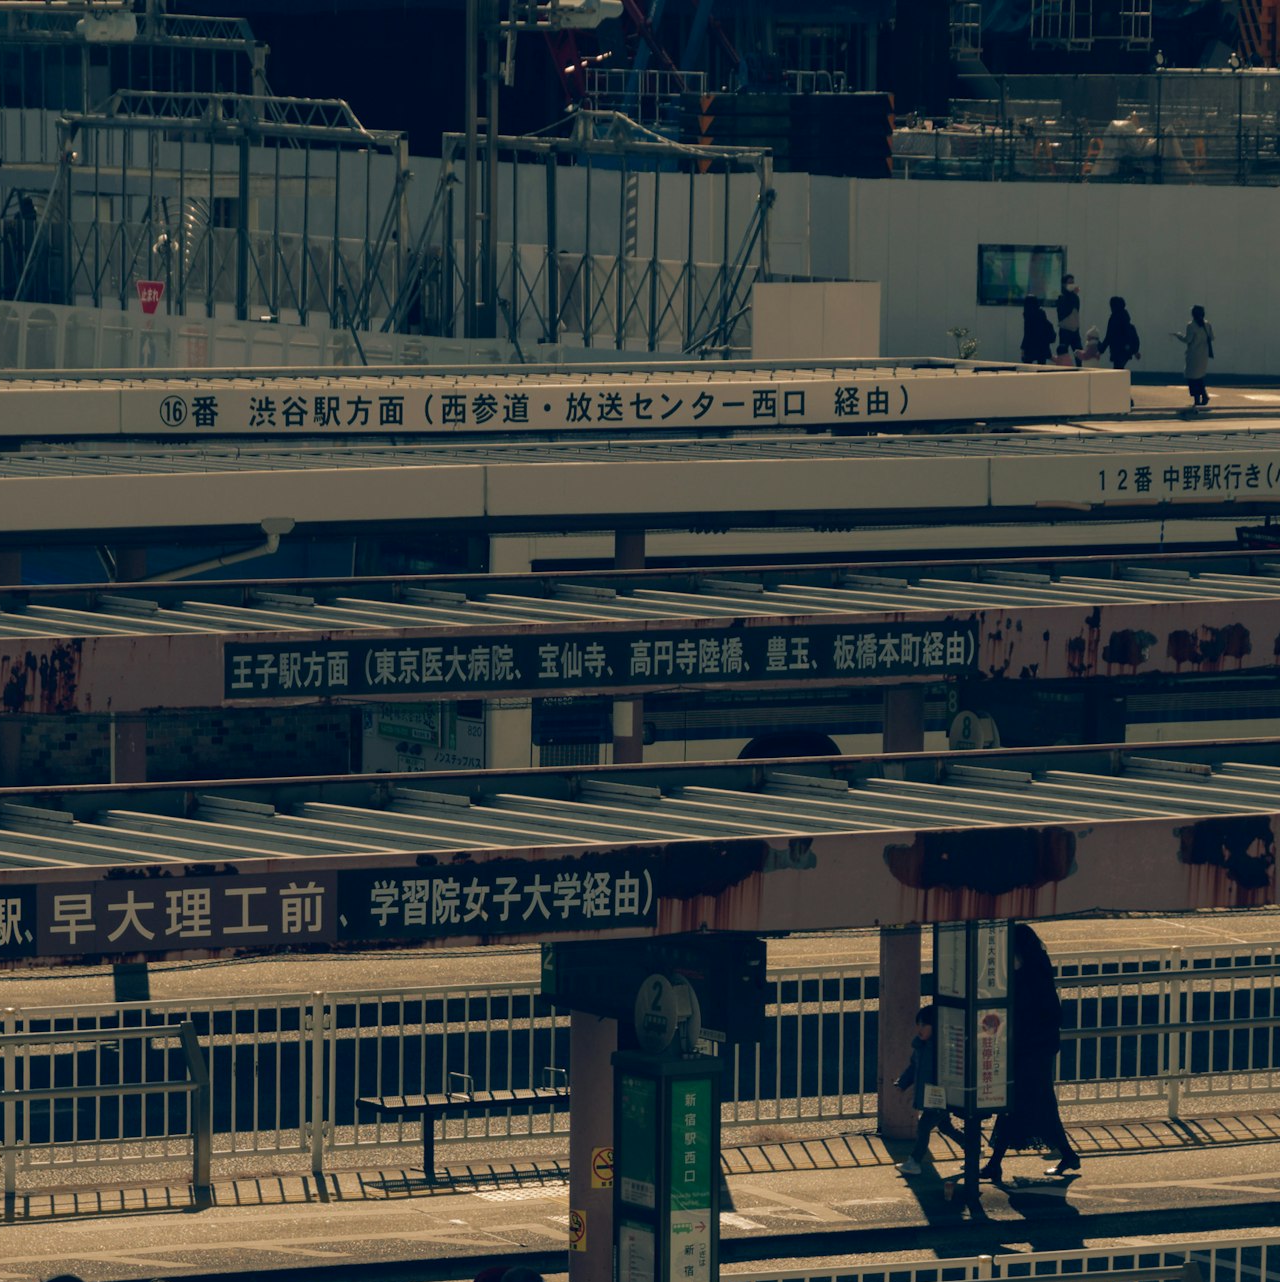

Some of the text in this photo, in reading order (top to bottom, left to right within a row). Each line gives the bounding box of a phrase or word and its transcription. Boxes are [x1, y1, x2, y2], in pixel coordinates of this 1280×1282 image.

[834, 385, 910, 416] 経由）
[947, 690, 958, 713] 8
[467, 725, 482, 737] 820
[962, 716, 972, 739] 8
[434, 752, 482, 769] ノンステップバス
[49, 881, 327, 945] 早大理工前
[543, 942, 554, 971] 2
[651, 980, 663, 1012] 2
[683, 1093, 697, 1183] 新宿駅西口
[698, 1242, 707, 1267] つぎは
